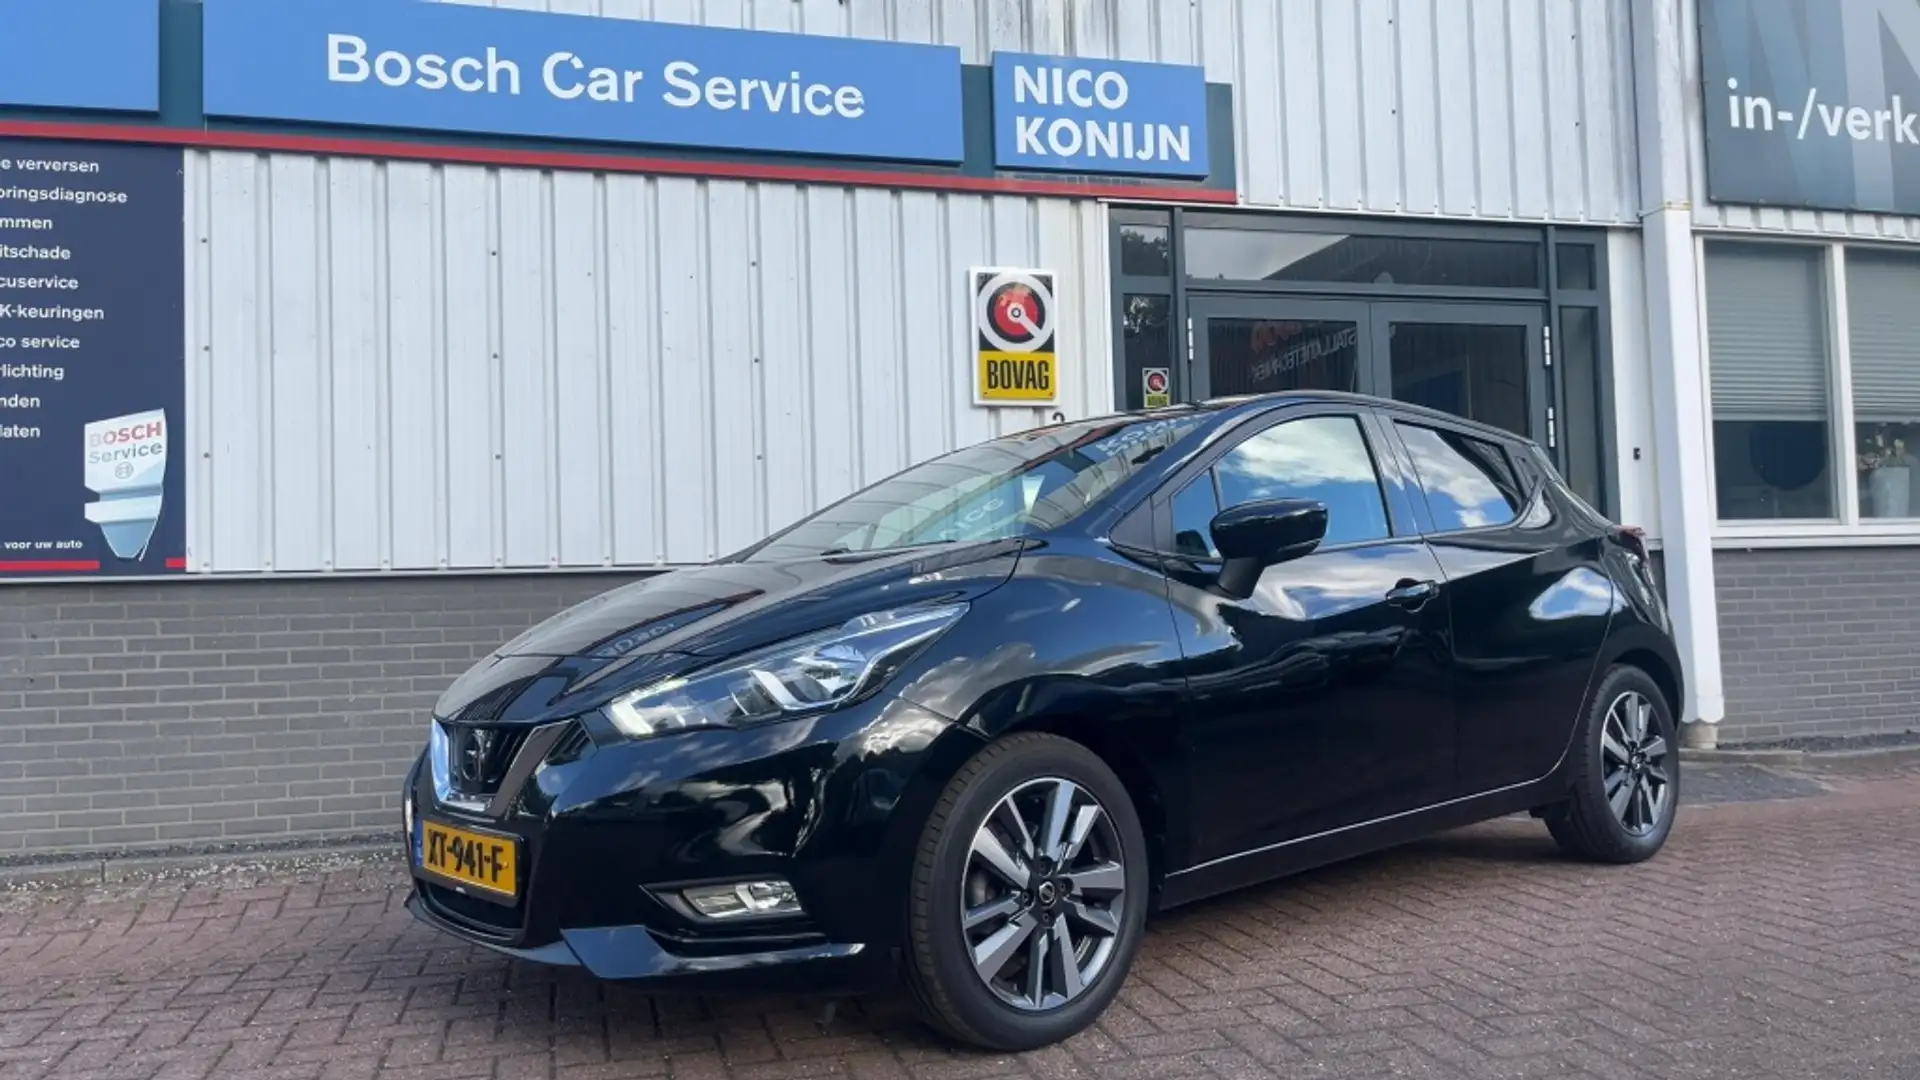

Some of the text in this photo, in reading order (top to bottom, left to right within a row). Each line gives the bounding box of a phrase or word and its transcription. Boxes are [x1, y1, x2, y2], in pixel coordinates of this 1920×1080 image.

[327, 32, 865, 119] Bosch Car Service
[1014, 65, 1129, 109] NICO
[1016, 116, 1191, 163] KONIJN
[16, 158, 100, 173] verversen
[0, 217, 53, 230] mmen
[0, 273, 80, 290] cuservice
[0, 304, 105, 322] K-keuringen
[21, 334, 80, 349] service
[986, 359, 1050, 391] BOVAG
[89, 421, 163, 447] BOSCH
[88, 442, 163, 465] Service
[4, 539, 83, 550] voor uw auto
[427, 828, 505, 883] XT-941-F
